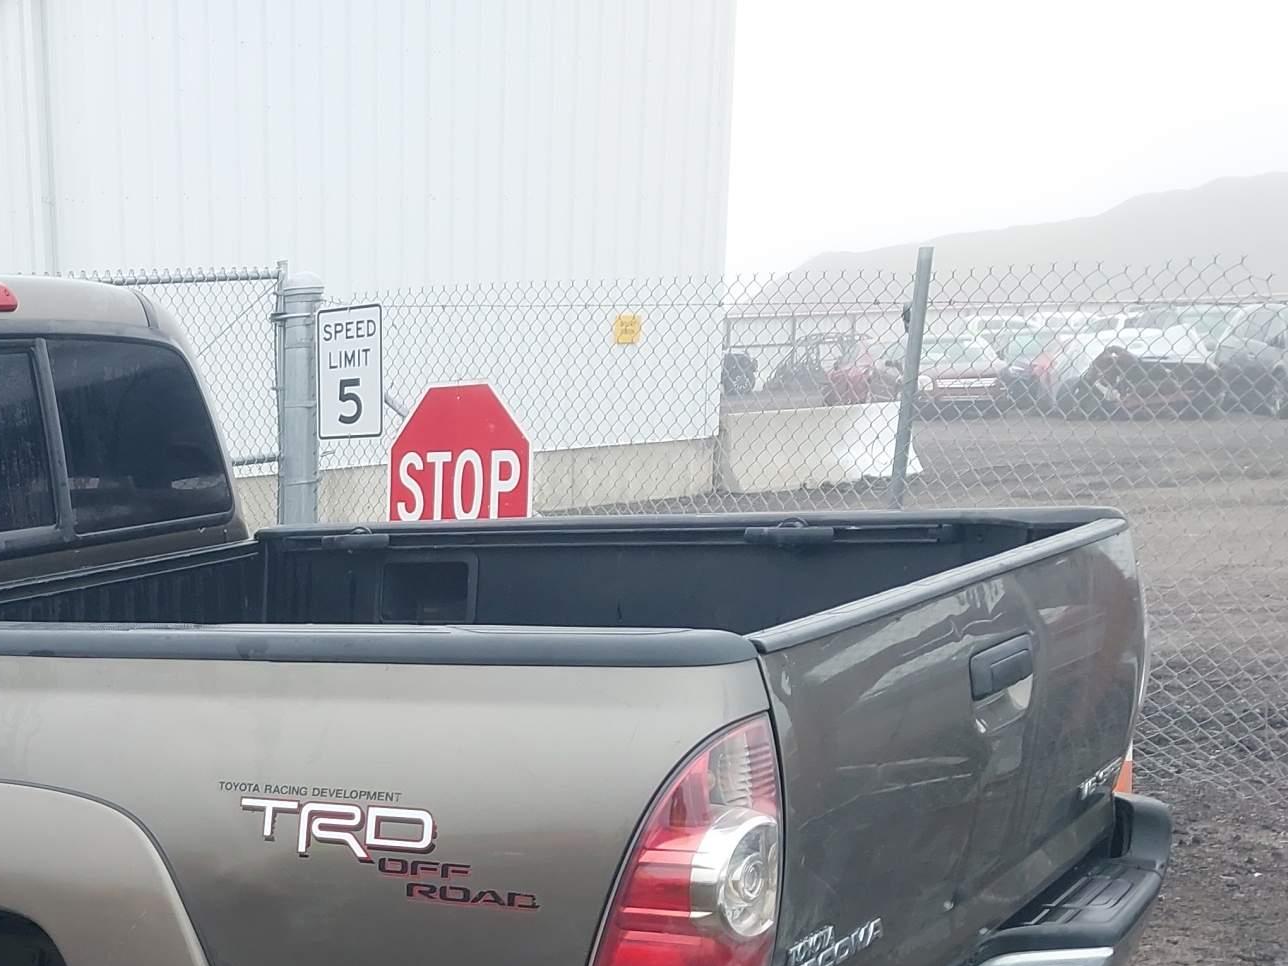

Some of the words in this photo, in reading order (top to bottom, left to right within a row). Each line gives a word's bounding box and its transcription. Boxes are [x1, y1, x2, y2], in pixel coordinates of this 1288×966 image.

[323, 319, 376, 341] SPEED
[328, 348, 371, 369] LIMIT
[338, 377, 363, 424] 5
[397, 448, 521, 521] STOP
[219, 781, 260, 793] TOYOTA
[264, 784, 308, 797] RACING
[311, 787, 403, 802] DEVELOPMENT
[240, 796, 438, 864] TRD
[378, 857, 472, 880] OFF
[406, 882, 541, 909] ROAD
[787, 925, 835, 966] TOYOTA
